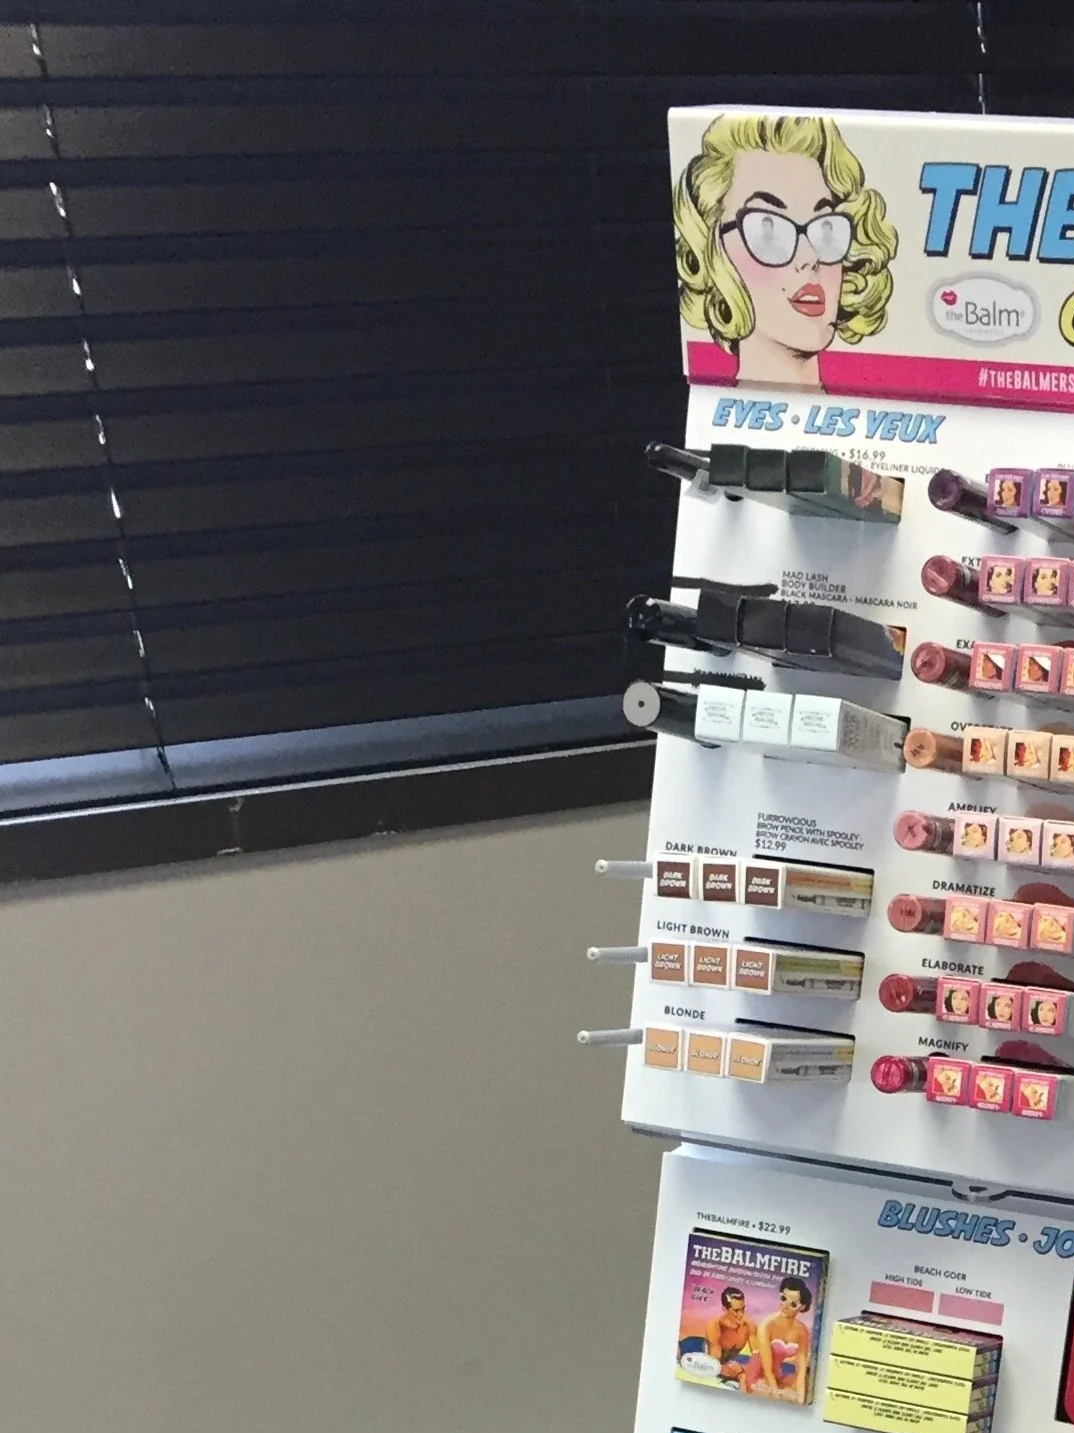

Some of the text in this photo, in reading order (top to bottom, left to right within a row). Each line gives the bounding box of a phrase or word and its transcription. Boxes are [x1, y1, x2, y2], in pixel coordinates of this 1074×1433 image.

[946, 300, 1020, 327] the Balm
[712, 398, 946, 444] EYES LES YEUX
[849, 449, 886, 460] $16.99
[871, 462, 908, 472] EYELINER
[782, 571, 828, 582] MAD LASH
[782, 580, 846, 593] BODY BUILDER
[781, 589, 806, 598] BLACK
[809, 592, 848, 603] MASCARA
[855, 597, 894, 607] MASCARA
[666, 841, 737, 856] DARK BROWN
[755, 839, 786, 851] $12.99
[932, 880, 996, 898] DRAMATIZE
[657, 920, 730, 939] LIGHT BROWN
[922, 958, 985, 976] ELABORATE
[664, 1005, 706, 1020] BLONDE
[918, 1036, 969, 1053] MAGNIFY
[758, 1221, 791, 1235] $22.99
[878, 1200, 1016, 1246] BLUSHES
[693, 1244, 811, 1278] THEBALMFIRE
[885, 1273, 922, 1288] HIGH TIDE
[914, 1264, 967, 1281] BEACH GOER
[956, 1286, 992, 1300] LOW TIDE
